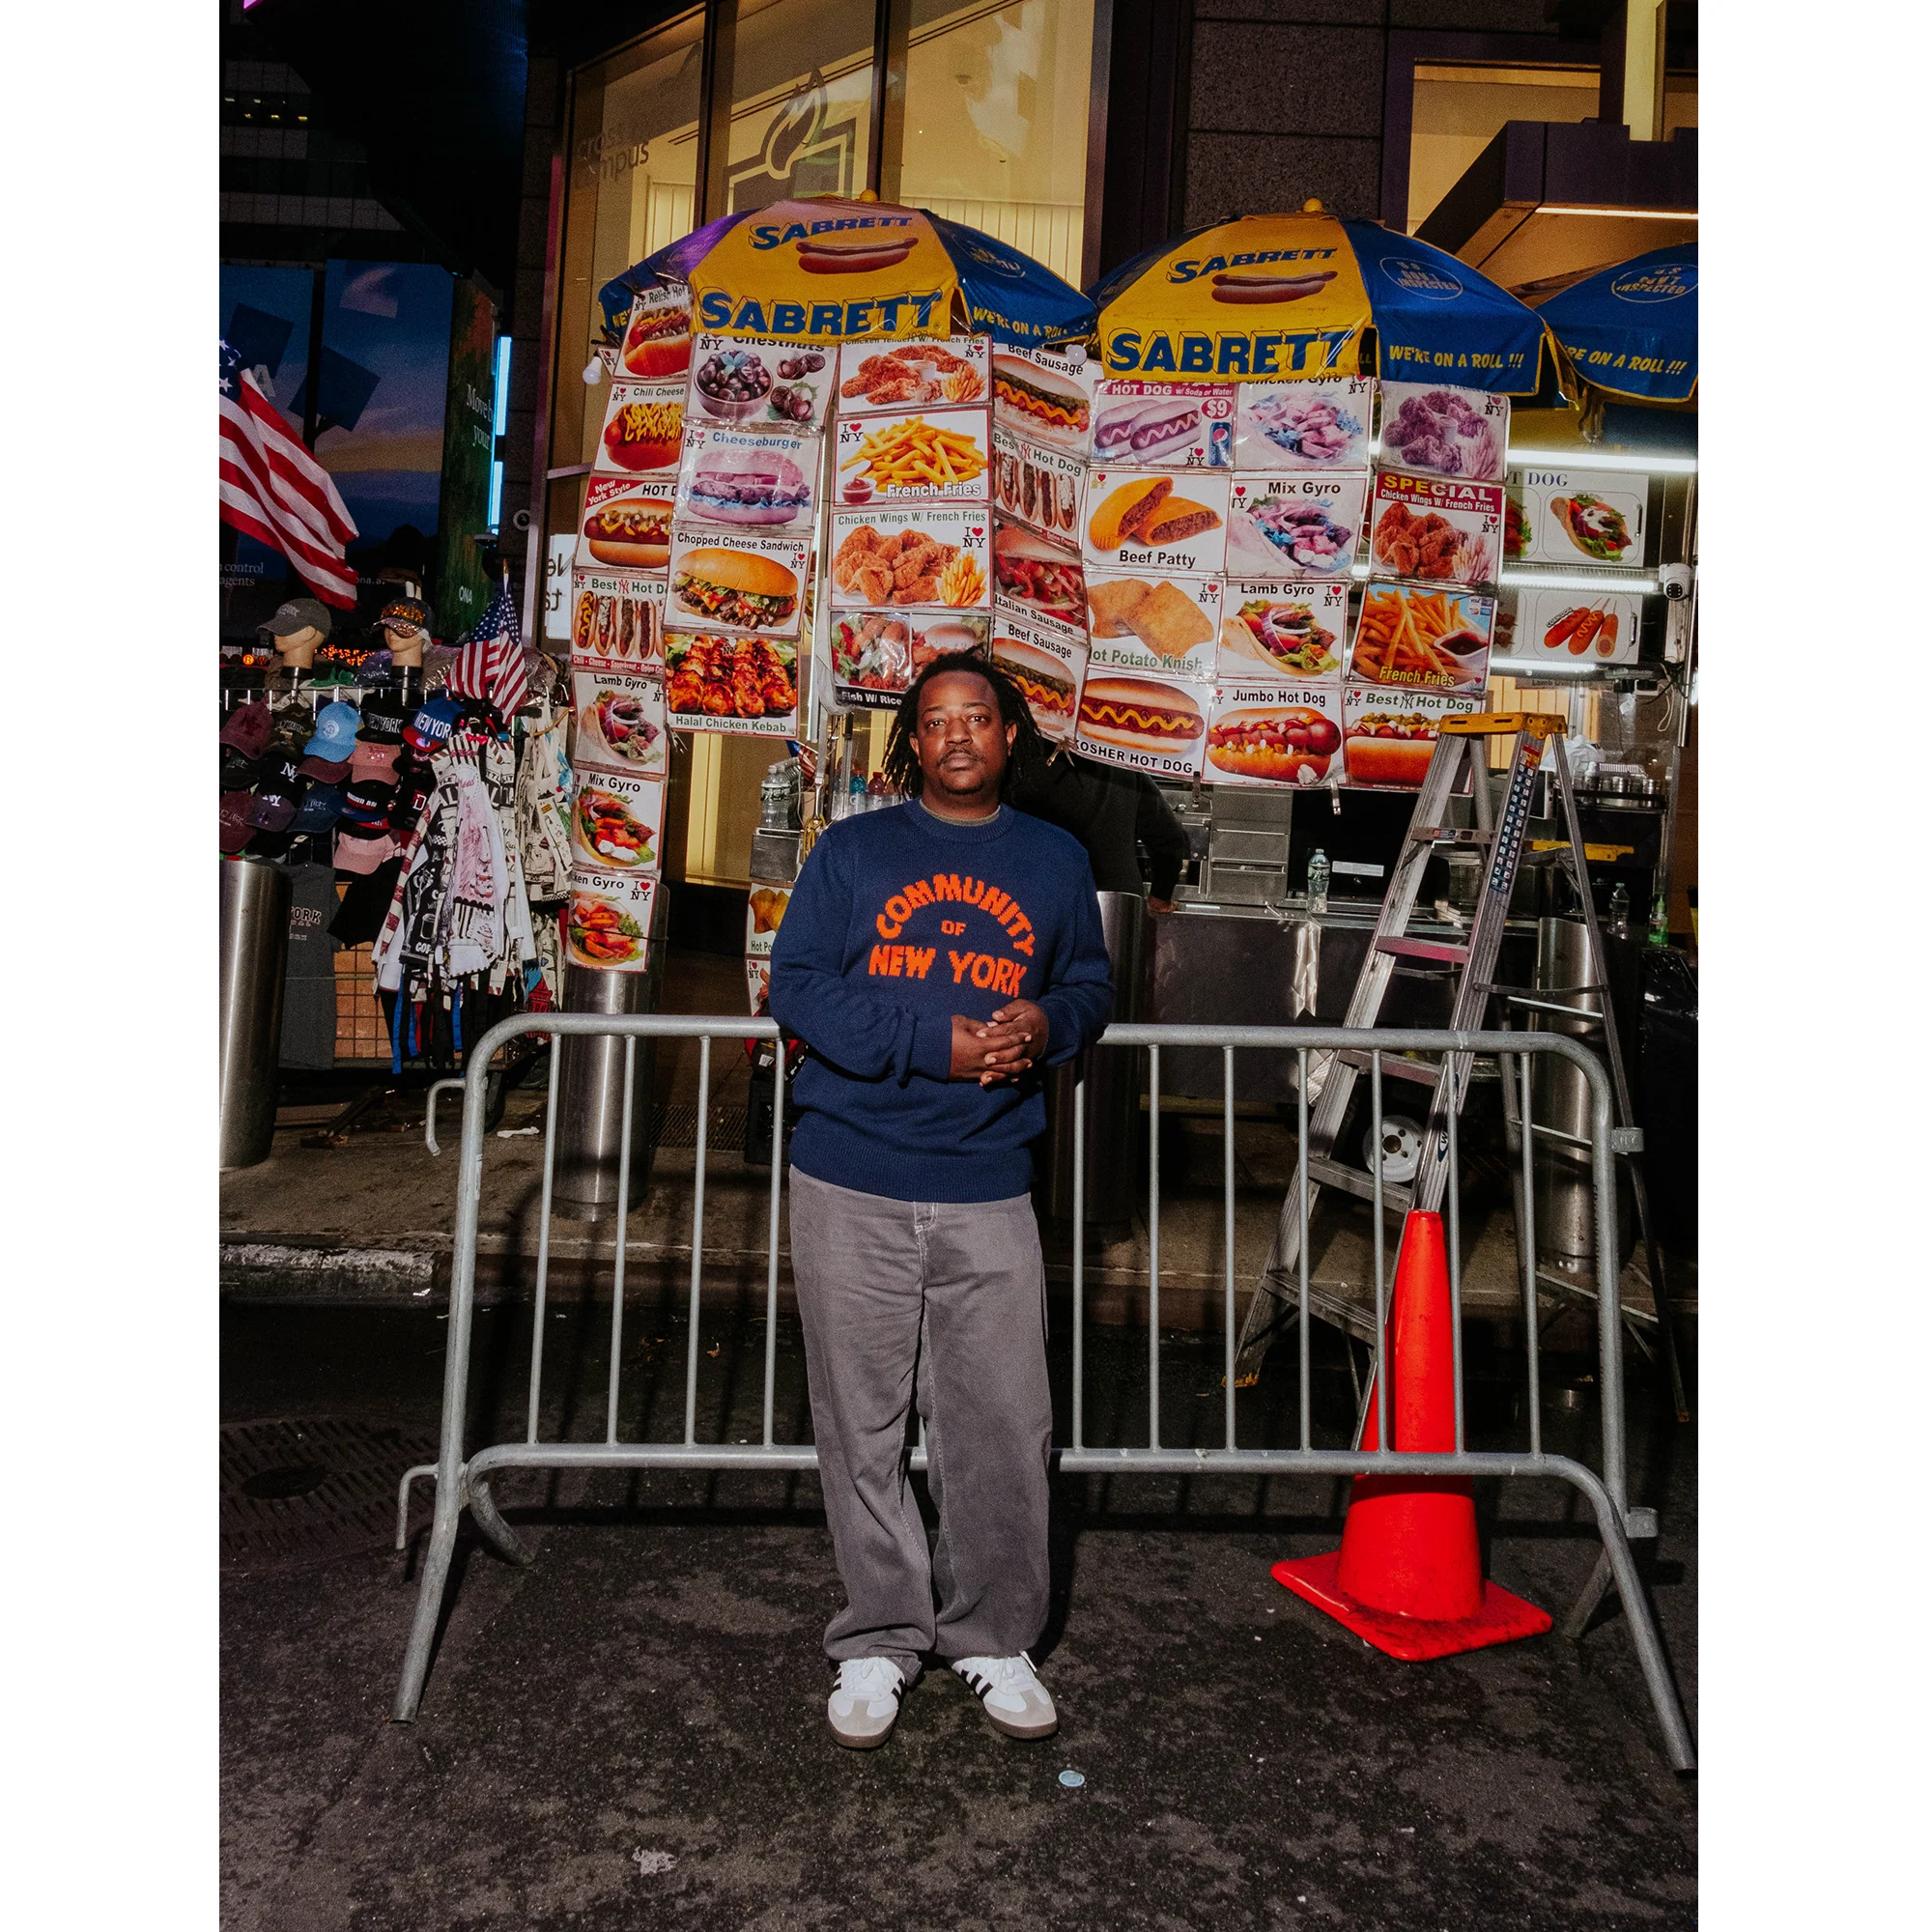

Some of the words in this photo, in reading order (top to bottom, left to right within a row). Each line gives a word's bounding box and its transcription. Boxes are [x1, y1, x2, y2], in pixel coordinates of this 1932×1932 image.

[749, 217, 912, 250] SABRETT
[1166, 247, 1338, 284] SABRETT
[699, 287, 943, 336] SABRETT
[1012, 322, 1029, 336] ON
[1033, 325, 1042, 336] A
[698, 339, 724, 351] NY
[964, 336, 984, 345] Fries
[1008, 344, 1034, 361] Beef
[1035, 353, 1084, 376] Sausage
[1106, 326, 1355, 375] SABRETT
[1389, 346, 1431, 363] WE'RE
[1434, 352, 1454, 367] ON
[1458, 354, 1467, 367] A
[1471, 354, 1504, 368] ROLL
[1588, 351, 1612, 365] ON
[1612, 354, 1627, 368] A
[1628, 355, 1664, 373] ROLL
[633, 387, 653, 397] Chili
[656, 387, 685, 397] Cheese
[1112, 384, 1140, 395] HOT
[1144, 385, 1172, 395] DOG
[1185, 387, 1203, 396] Soda
[1208, 399, 1228, 418] $9
[712, 431, 803, 449] Cheeseburger
[1034, 449, 1054, 467] Hot
[1058, 458, 1082, 477] Dog
[595, 480, 616, 495] New
[1384, 474, 1492, 501] SPECIAL
[1528, 471, 1568, 487] DOG
[588, 494, 608, 505] York
[610, 483, 631, 497] Style
[642, 485, 668, 496] HOT
[887, 482, 940, 499] French
[943, 481, 981, 497] Fries
[1268, 482, 1296, 494] Mix
[1302, 482, 1341, 497] Gyro
[1380, 488, 1409, 501] Chicken
[1411, 494, 1432, 506] Wings
[1435, 497, 1444, 507] W/
[1445, 498, 1473, 510] French
[1475, 502, 1495, 513] Fries
[838, 514, 876, 526] Chicken
[879, 513, 908, 525] Wings
[911, 512, 924, 523] W/
[926, 511, 959, 522] French
[962, 510, 986, 523] Fries
[677, 532, 720, 548] Chopped
[723, 537, 757, 550] Cheese
[760, 540, 804, 553] Sandwich
[224, 561, 265, 574] control
[1120, 550, 1152, 564] Beef
[1157, 552, 1196, 569] Patty
[591, 579, 617, 591] Best
[632, 582, 652, 593] Hot
[1241, 583, 1278, 595] Lamb
[1283, 583, 1315, 597] Gyro
[994, 593, 1027, 616] Italian
[1031, 610, 1073, 636] Sausage
[1009, 623, 1031, 642] Beef
[1033, 633, 1072, 659] Sausage
[1112, 649, 1157, 668] Potato
[1163, 654, 1203, 671] Knish
[594, 674, 622, 687] Lamb
[625, 677, 647, 690] Gyro
[1378, 666, 1421, 683] French
[1424, 669, 1456, 688] Fries
[841, 691, 863, 702] Fish
[880, 695, 902, 706] Rice
[1233, 690, 1274, 702] Jumbo
[1278, 691, 1299, 703] Hot
[1303, 692, 1325, 707] Dog
[1366, 693, 1399, 705] Best
[1416, 696, 1441, 708] Hot
[1446, 698, 1473, 713] Dog
[413, 712, 432, 732] NEW
[676, 716, 702, 726] Halal
[705, 718, 749, 730] Chicken
[752, 721, 786, 733] Kebab
[1074, 740, 1125, 762] KOSHER
[1129, 753, 1158, 768] HOT
[1163, 760, 1193, 774] DOG
[588, 773, 605, 787] Mix
[609, 777, 640, 793] Gyro
[592, 876, 625, 890] Gyro
[875, 873, 1036, 956] COMMUNITY
[941, 920, 966, 936] OF
[751, 941, 762, 952] Hot
[867, 945, 936, 980] NEW
[949, 951, 1027, 998] YORK
